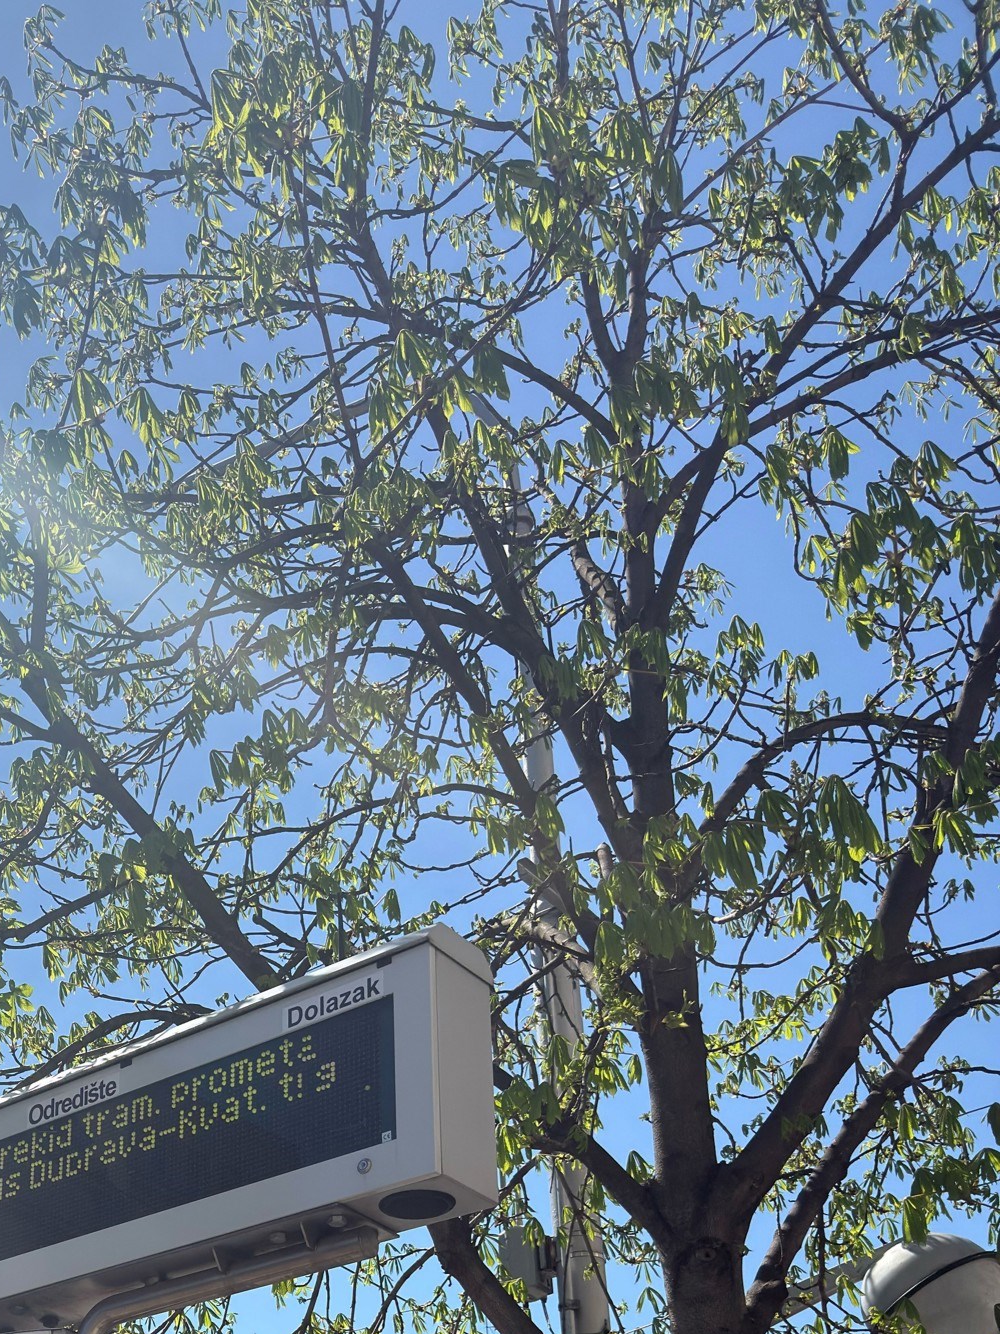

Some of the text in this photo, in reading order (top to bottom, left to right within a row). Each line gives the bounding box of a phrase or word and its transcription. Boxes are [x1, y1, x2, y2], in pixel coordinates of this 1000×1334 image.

[287, 977, 380, 1029] Dolazak
[28, 1080, 117, 1126] Odredište
[83, 1094, 160, 1138] tram.
